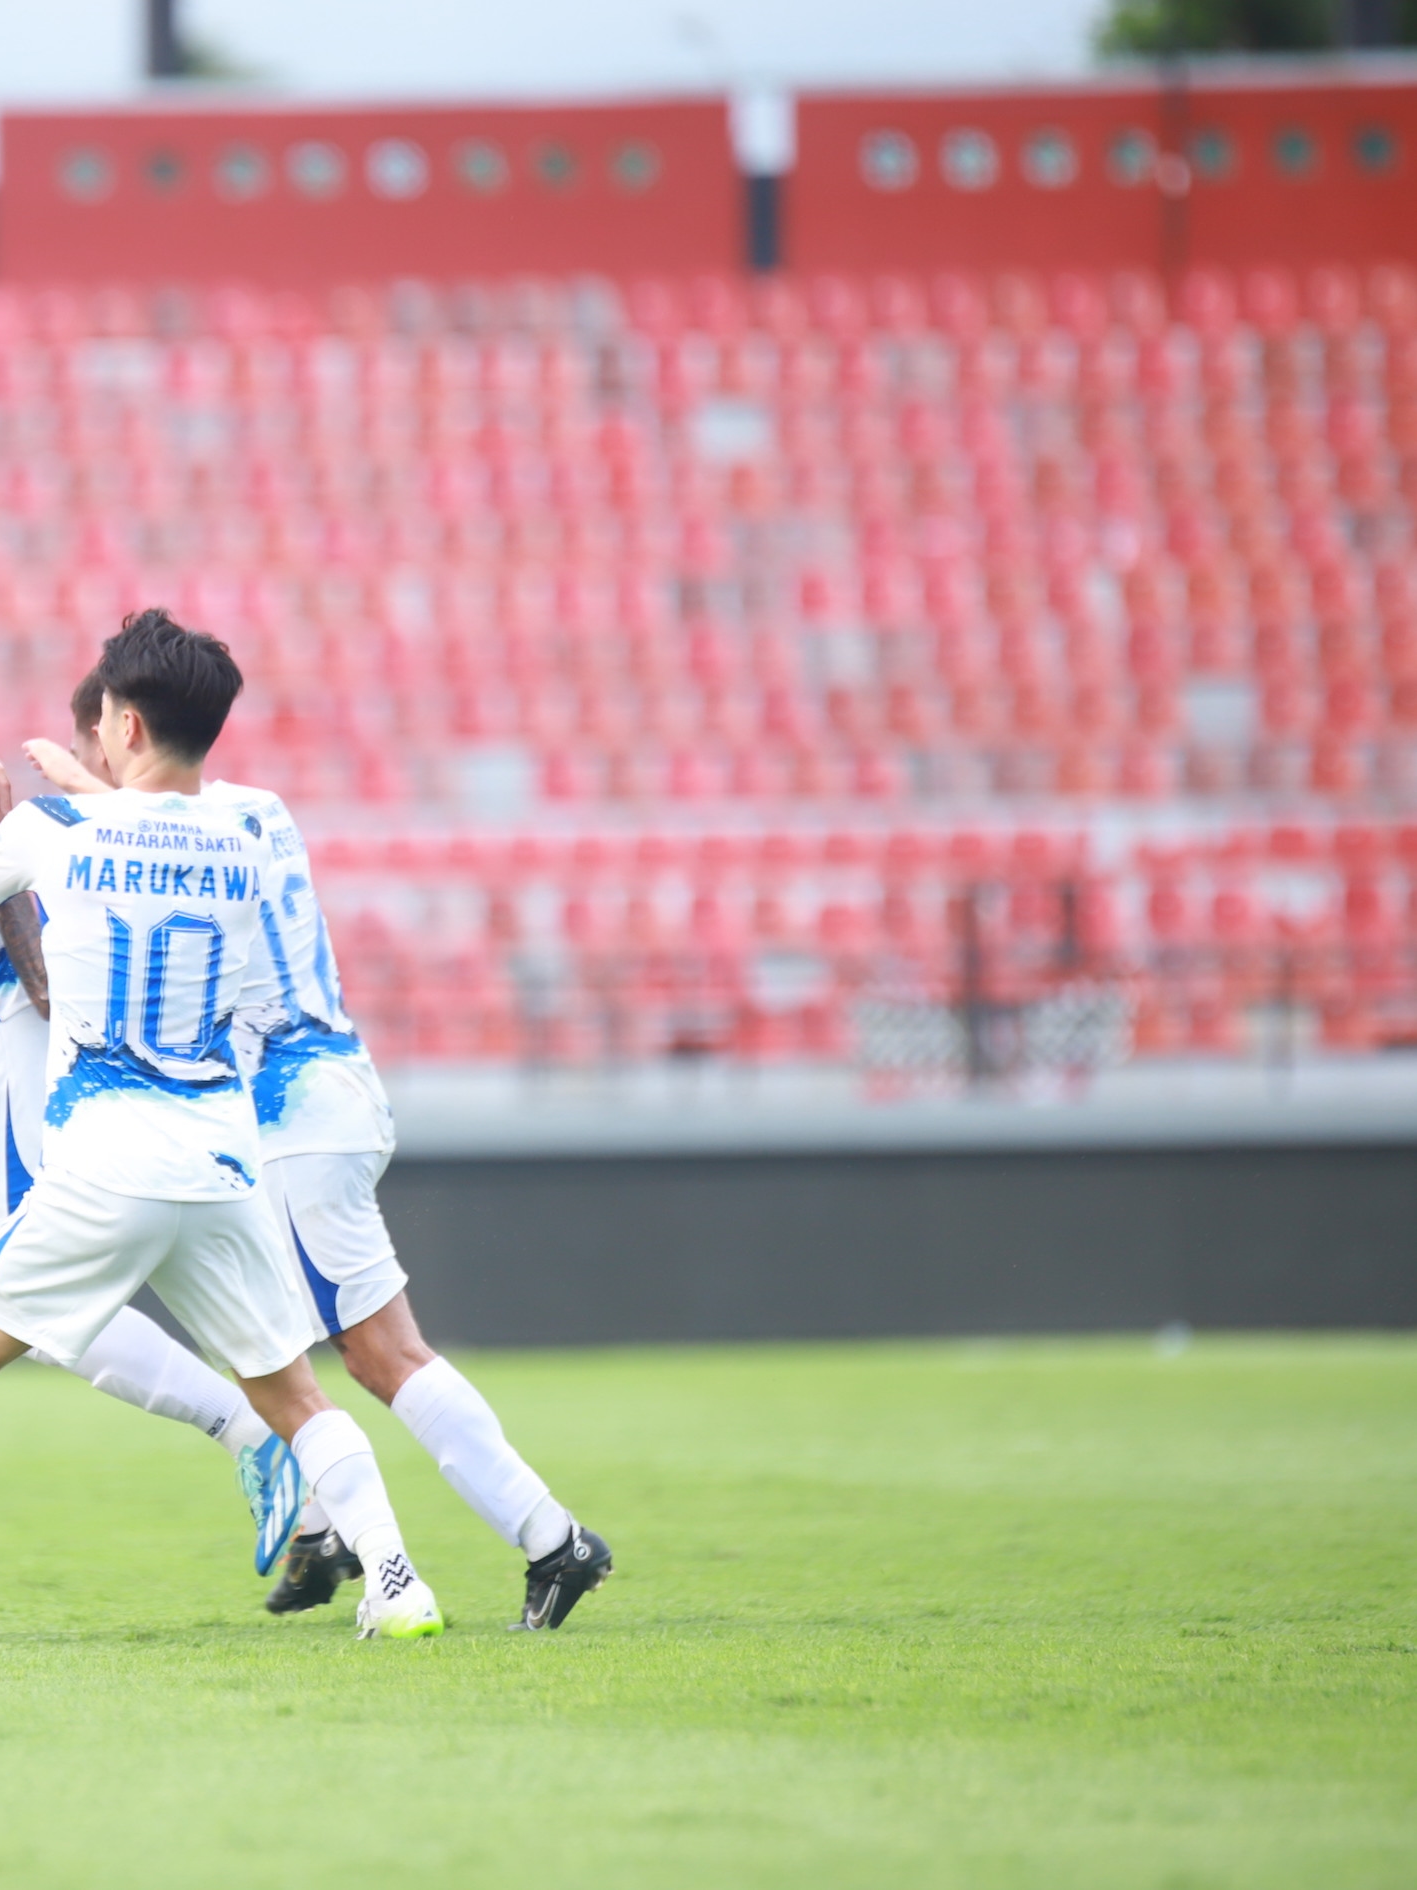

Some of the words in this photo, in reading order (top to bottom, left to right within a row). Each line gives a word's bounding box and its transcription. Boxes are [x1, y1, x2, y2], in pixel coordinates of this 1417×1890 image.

[96, 828, 189, 851] MATARAM
[194, 836, 242, 852] SAKTI
[153, 820, 202, 836] YAMAHA
[66, 854, 261, 902] MARUKAWA
[105, 905, 225, 1064] 10
